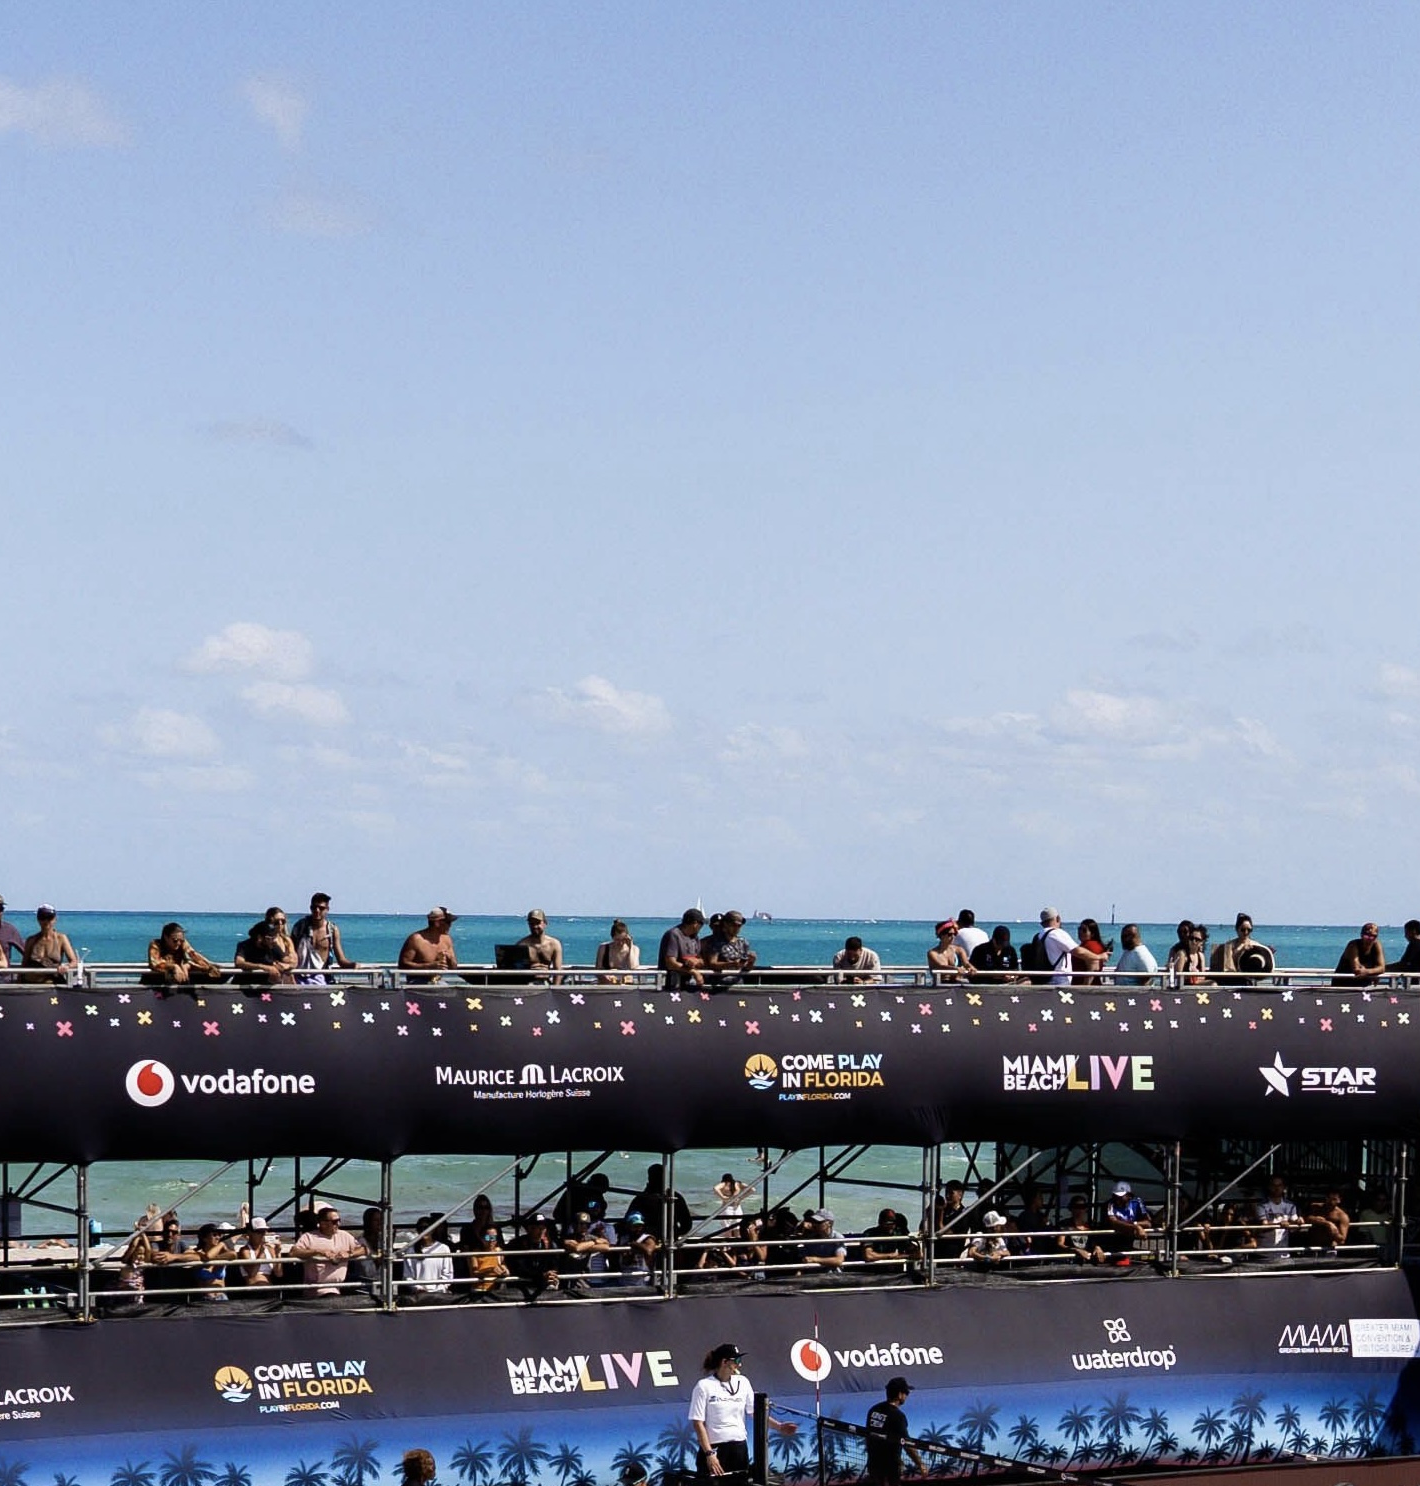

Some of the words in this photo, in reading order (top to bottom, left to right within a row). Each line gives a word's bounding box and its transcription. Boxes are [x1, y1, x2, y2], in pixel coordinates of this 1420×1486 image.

[781, 1054, 835, 1071] COME
[837, 1053, 883, 1069] PLAY
[1003, 1055, 1075, 1074] MIAMI
[1066, 1055, 1154, 1090] LIVE
[181, 1067, 316, 1095] vodafone
[435, 1066, 515, 1086] MAURICE
[549, 1065, 625, 1084] LACROIX
[782, 1072, 801, 1089] IN
[804, 1070, 884, 1088] FLORIDA
[1003, 1073, 1063, 1090] BEACH
[1301, 1066, 1377, 1087] STAR
[1330, 1087, 1345, 1097] by
[1279, 1323, 1349, 1347] MIAMI
[508, 1354, 588, 1379] MIAMI
[834, 1342, 944, 1371] vodafone
[1071, 1345, 1176, 1371] waterdrop
[254, 1361, 315, 1382] COME
[317, 1360, 367, 1379] PLAY
[577, 1350, 679, 1391] LIVE
[258, 1381, 279, 1400] IN
[283, 1374, 374, 1397] FLORIDA
[509, 1373, 579, 1396] BEACH
[12, 1408, 41, 1421] Suisse
[259, 1400, 340, 1414] PLAYINFLORIDA.COM
